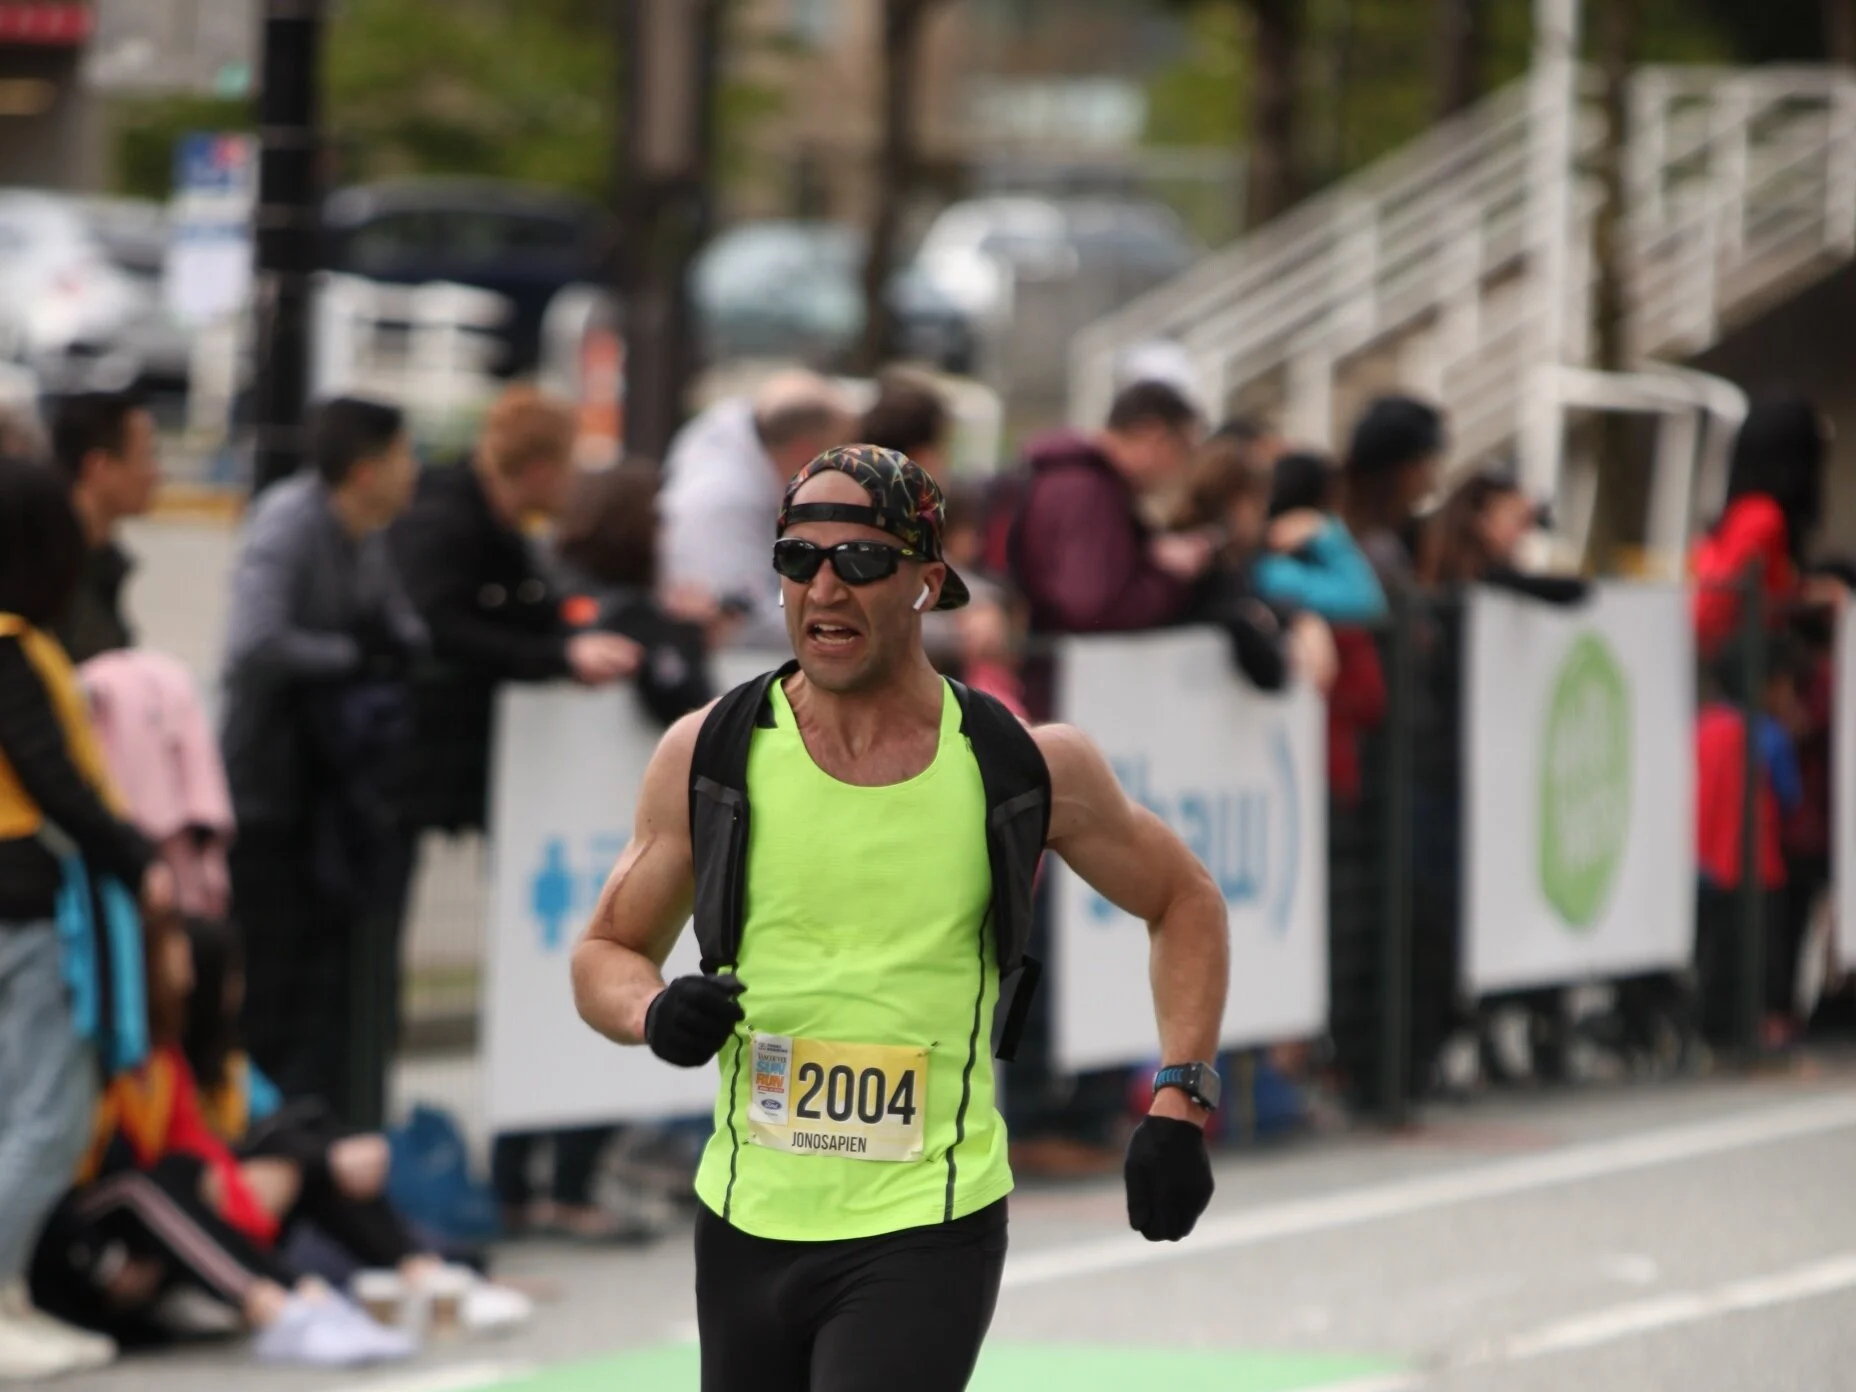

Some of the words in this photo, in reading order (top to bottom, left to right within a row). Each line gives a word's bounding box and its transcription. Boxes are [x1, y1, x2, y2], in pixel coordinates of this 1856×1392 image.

[757, 1060, 786, 1075] SUN
[756, 1072, 784, 1088] RUN
[796, 1062, 917, 1126] 2004
[791, 1131, 868, 1153] JONOSAPIEN
